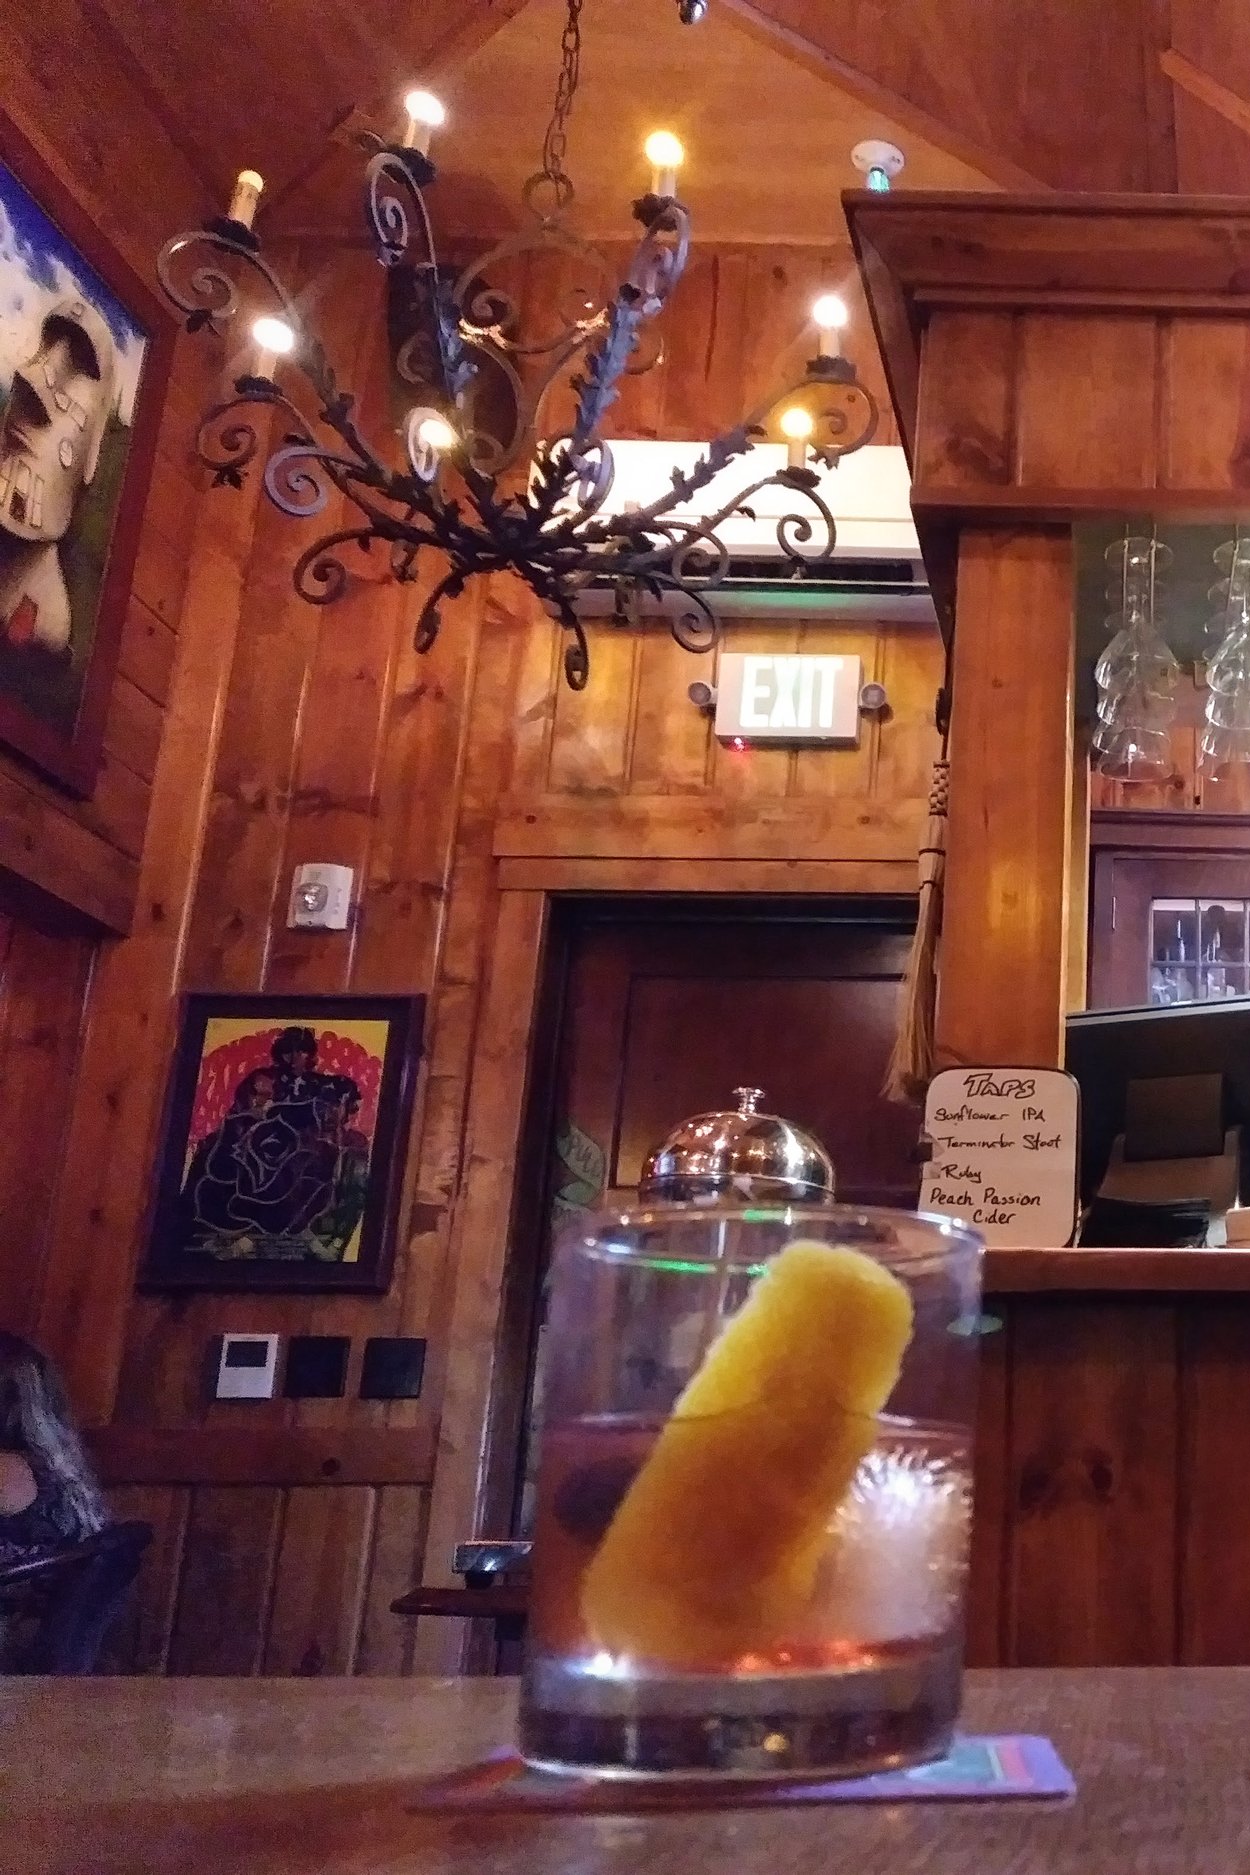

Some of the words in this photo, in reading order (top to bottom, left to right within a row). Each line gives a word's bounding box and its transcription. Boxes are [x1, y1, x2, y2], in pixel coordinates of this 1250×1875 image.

[739, 656, 844, 728] EXIT
[1022, 1106, 1045, 1122] IPA
[930, 1187, 974, 1206] Peach
[983, 1187, 1041, 1206] Passion
[973, 1209, 1016, 1224] Cider
